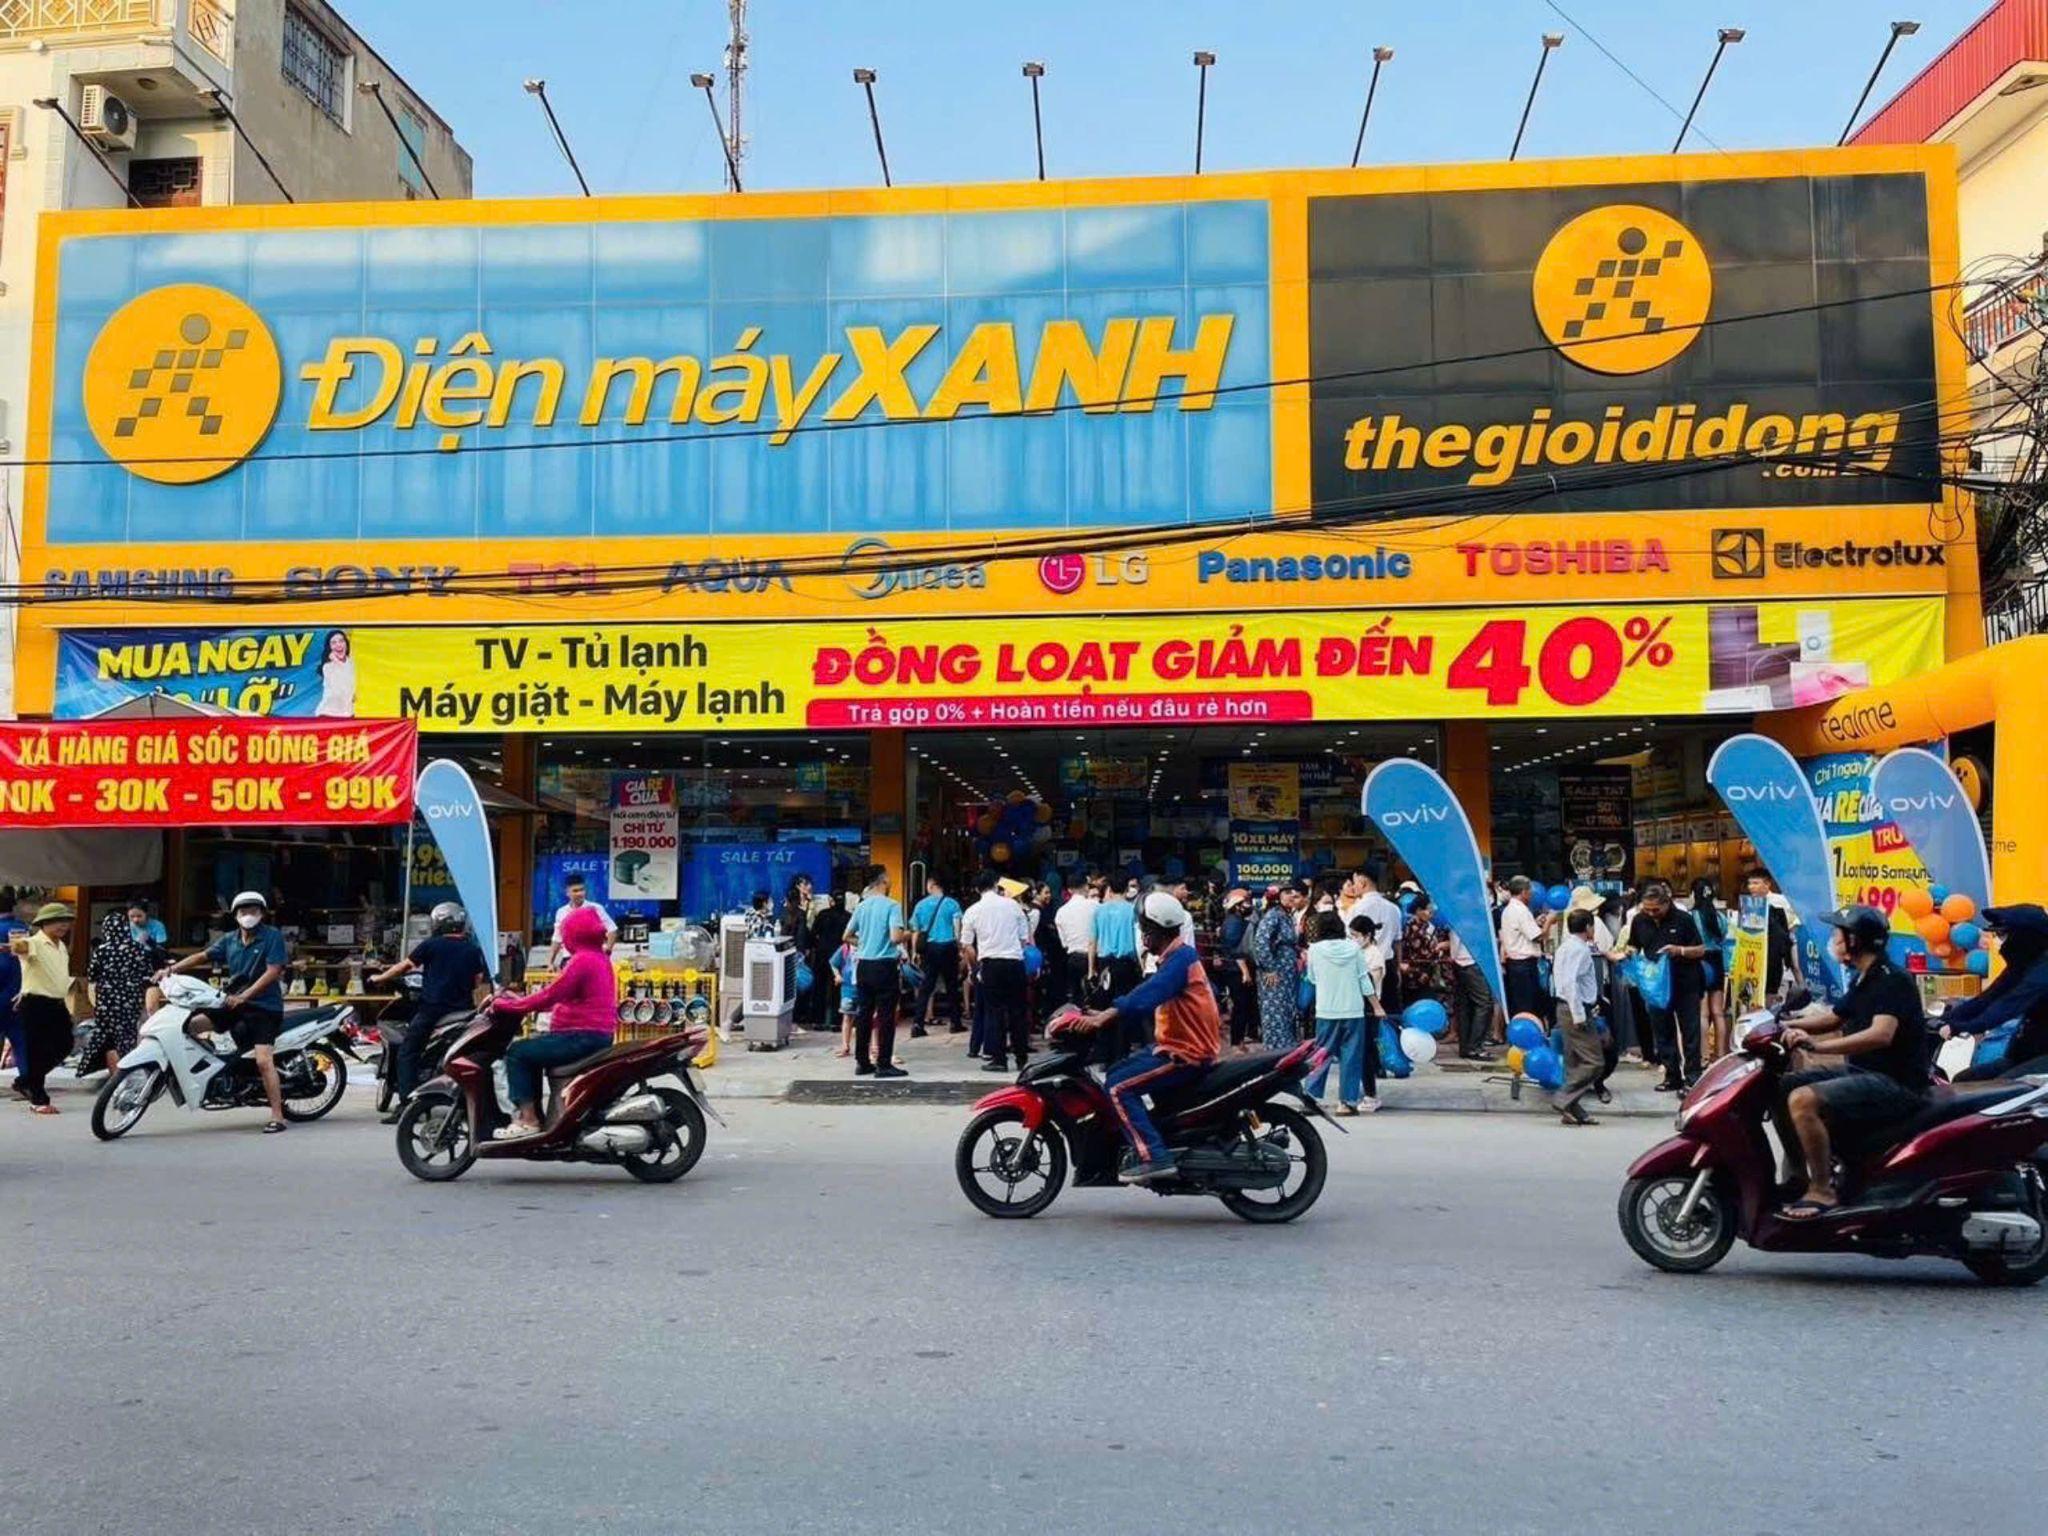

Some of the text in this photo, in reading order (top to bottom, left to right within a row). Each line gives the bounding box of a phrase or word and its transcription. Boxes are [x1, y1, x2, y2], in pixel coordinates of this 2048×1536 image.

[299, 331, 566, 453] Điện
[822, 314, 1236, 422] XANH
[1344, 403, 1903, 486] thegioididong
[1095, 551, 1150, 585] LG
[1198, 547, 1412, 582] Panasonic
[1457, 538, 1671, 577] TOSHIBA
[1774, 540, 1946, 571] Electrolux
[45, 568, 235, 600] SAMSUNG
[283, 565, 461, 600] SONY
[97, 632, 316, 681] MUA NGAY
[475, 637, 529, 670] TV
[561, 632, 609, 669] Tủ
[620, 634, 708, 676] lạnh
[812, 616, 1675, 707] ĐỒNG LOẠT GIẢM ĐẾN 40%
[400, 682, 483, 726] Máy
[492, 682, 570, 726] giặt
[604, 680, 687, 723] Máy
[696, 681, 785, 723] lạnh
[848, 703, 883, 721] Trả
[889, 702, 929, 726] góp
[935, 703, 966, 721] 0%
[991, 700, 1046, 720] Hoàn
[1226, 699, 1267, 716] hơn
[1819, 701, 1897, 743] realme
[58, 729, 128, 766] HÀNG
[136, 729, 179, 765] GIÁ
[187, 724, 240, 764] SỐC
[326, 728, 371, 765] GIÁ
[95, 778, 169, 812] 30K
[211, 776, 285, 811] 50K
[325, 775, 399, 810] 99K
[1726, 781, 1798, 801] oviv
[1890, 791, 1955, 812] oviv
[427, 801, 473, 819] oviv
[1381, 803, 1449, 827] oviv
[612, 836, 677, 849] 1.190.000
[720, 851, 760, 864] SALE
[562, 860, 598, 872] SALE
